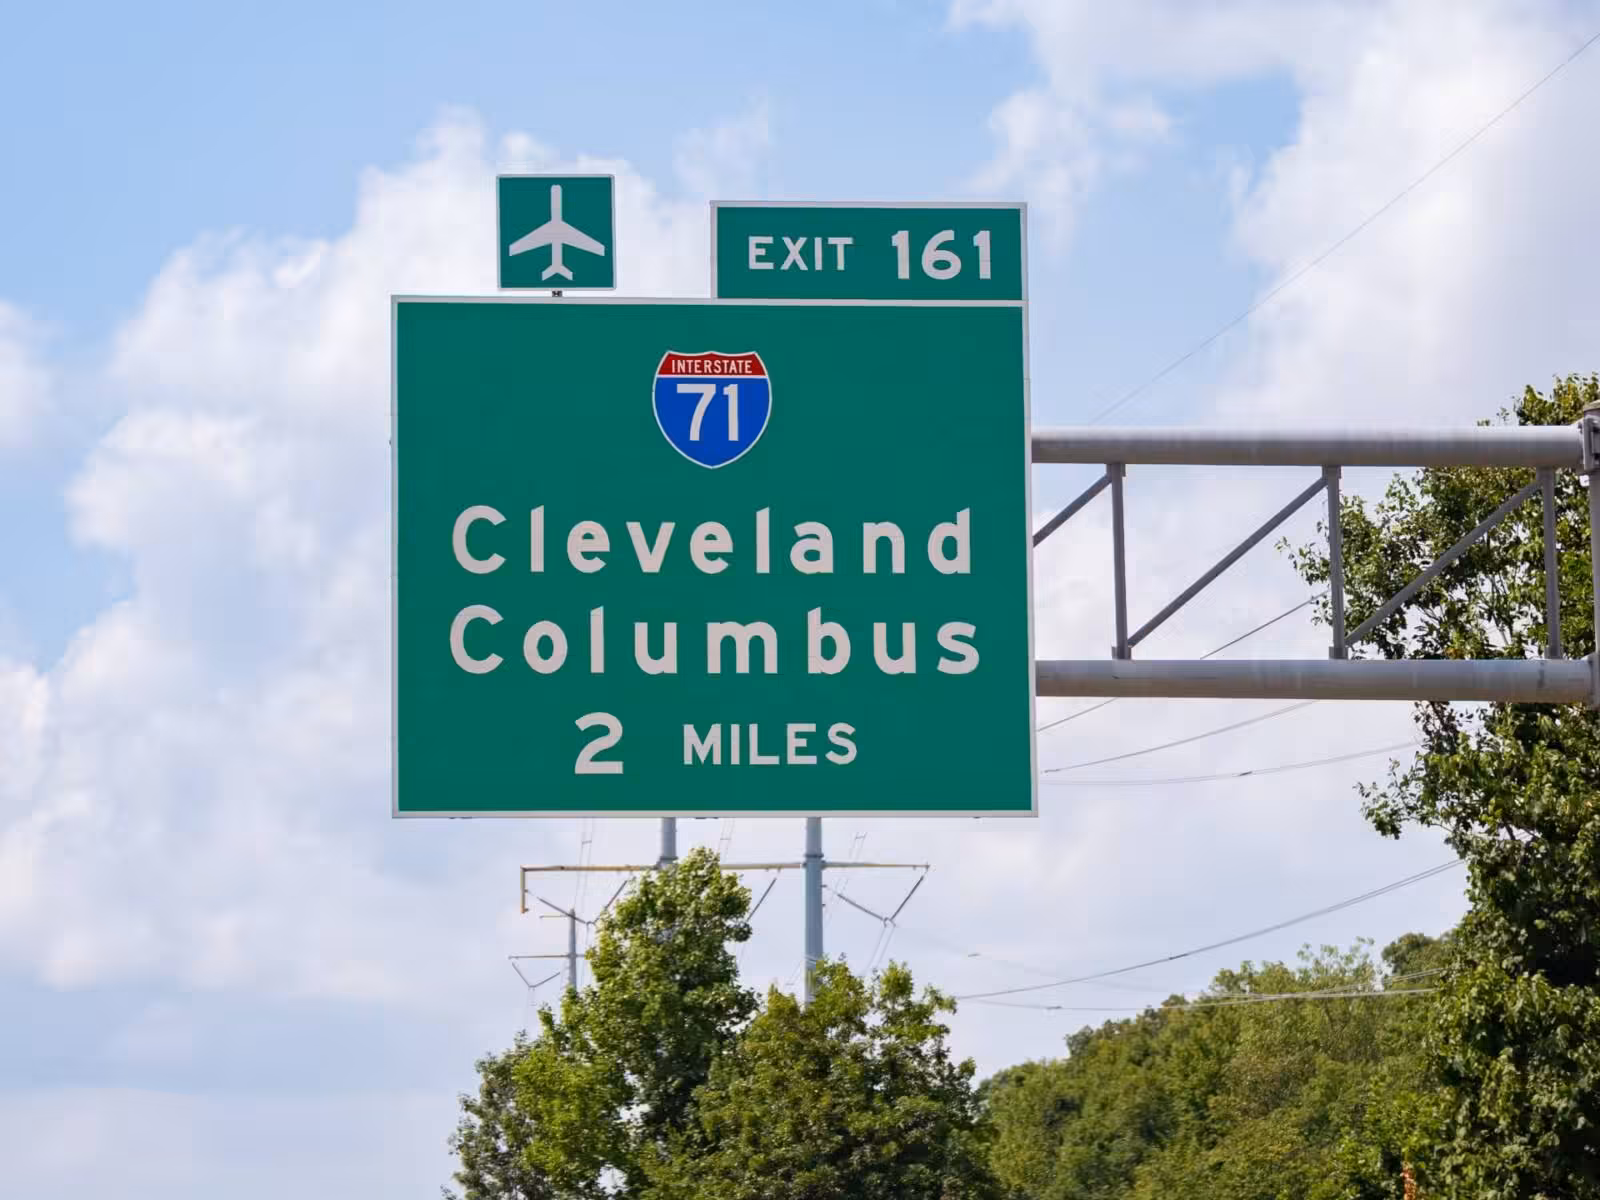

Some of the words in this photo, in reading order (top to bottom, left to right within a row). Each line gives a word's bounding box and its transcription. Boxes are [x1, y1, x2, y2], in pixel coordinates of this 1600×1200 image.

[748, 235, 853, 271] EXIT
[892, 229, 992, 280] 161
[671, 359, 753, 374] INTERSTATE
[676, 383, 739, 442] 71
[452, 505, 971, 575] Cleveland
[450, 604, 980, 675] Columbus
[574, 711, 624, 775] 2
[683, 722, 858, 765] MILES
